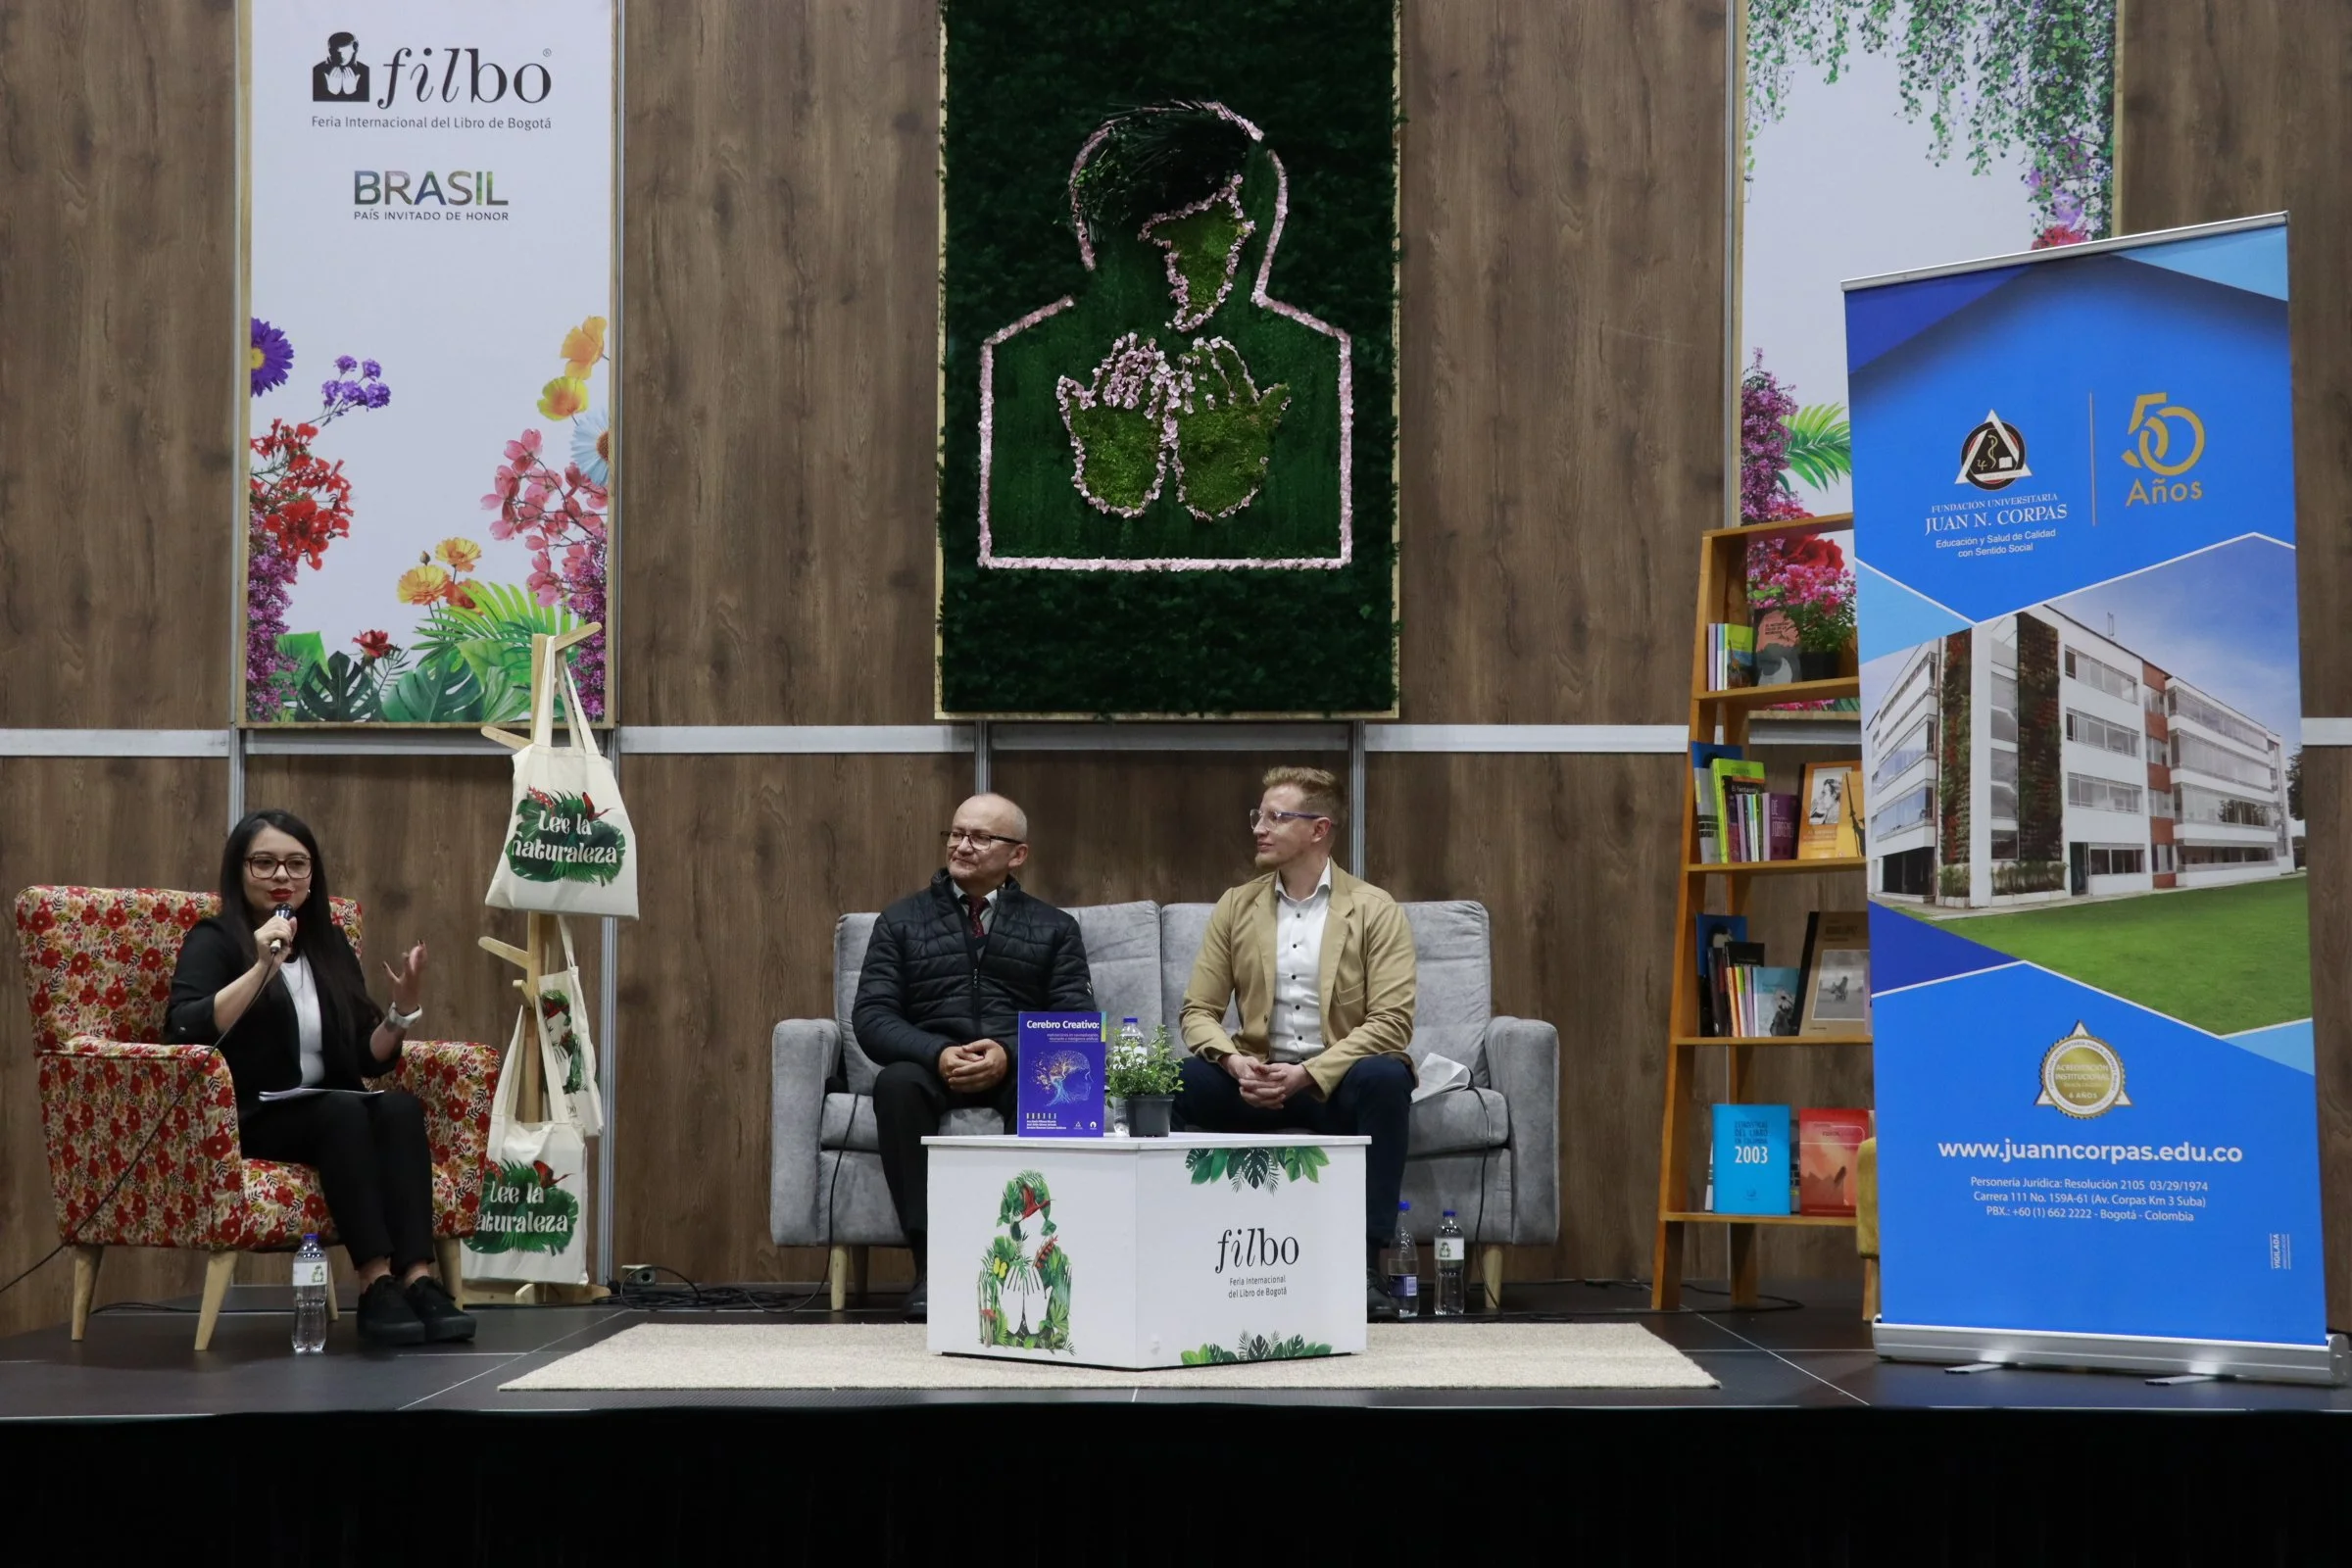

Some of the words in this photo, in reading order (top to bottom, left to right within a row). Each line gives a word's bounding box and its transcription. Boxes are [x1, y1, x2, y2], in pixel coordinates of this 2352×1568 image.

[377, 47, 552, 110] filbo
[312, 116, 341, 127] Feria
[345, 116, 427, 128] Internacional
[431, 116, 451, 128] del
[454, 117, 484, 128] Libro
[489, 117, 504, 128] de
[508, 117, 552, 131] Bogotá
[354, 171, 509, 206] BRASIL
[354, 208, 379, 220] PAÍS
[384, 211, 441, 220] INVITADO
[446, 211, 462, 220] DE
[466, 211, 509, 220] HONOR
[2126, 478, 2202, 507] Años
[1932, 499, 1985, 514] FUNDACIÓN
[1987, 493, 2058, 508] UNIVERSITARIA
[1925, 514, 1969, 536] JUAN
[1974, 512, 1992, 528] N.
[1997, 504, 2068, 525] CORPAS
[1936, 536, 1978, 549] Educación
[1980, 537, 1985, 546] y
[1987, 534, 2010, 544] Salud
[2012, 532, 2023, 541] de
[2025, 528, 2057, 539] Calidad
[1975, 546, 2007, 557] Sentido
[2008, 543, 2034, 553] Social
[538, 809, 570, 834] Lee
[576, 812, 592, 835] la
[512, 838, 617, 863] naturaleza
[1026, 1019, 1060, 1029] Cerebro
[1062, 1019, 1100, 1029] Creativo:
[1735, 1146, 1768, 1164] 2003
[1937, 1138, 2243, 1165] www.juanncorpas.edu.co
[490, 1181, 520, 1204] Lee
[526, 1182, 544, 1204] la
[1971, 1176, 2021, 1188] Personería
[2023, 1177, 2062, 1189] Jurídica:
[2064, 1178, 2118, 1190] Resolución
[2120, 1179, 2146, 1191] 2105
[2149, 1180, 2209, 1193] 03/29/1974
[1974, 1191, 2008, 1202] Carrera
[2011, 1192, 2027, 1202] 111
[2030, 1193, 2046, 1203] No.
[2050, 1194, 2088, 1204] 159A-61
[2090, 1194, 2110, 1205] (Av.
[2112, 1194, 2146, 1206] Corpas
[2149, 1195, 2166, 1205] Km
[2168, 1196, 2175, 1205] 3
[2177, 1196, 2206, 1207] Suba)
[474, 1210, 568, 1233] aturaleza
[2012, 1206, 2031, 1217] +60
[2033, 1206, 2045, 1219] (1)
[2047, 1207, 2066, 1218] 662
[2069, 1207, 2092, 1219] 2222
[2100, 1208, 2136, 1222] Bogotá
[2144, 1210, 2195, 1222] Colombia
[1215, 1227, 1299, 1274] filbo
[1229, 1277, 1245, 1286] Feria
[1246, 1274, 1287, 1285] Internacional
[1228, 1289, 1238, 1298] del
[1240, 1288, 1255, 1298] Libro
[1256, 1287, 1264, 1297] de
[1265, 1286, 1288, 1298] Bogotá
